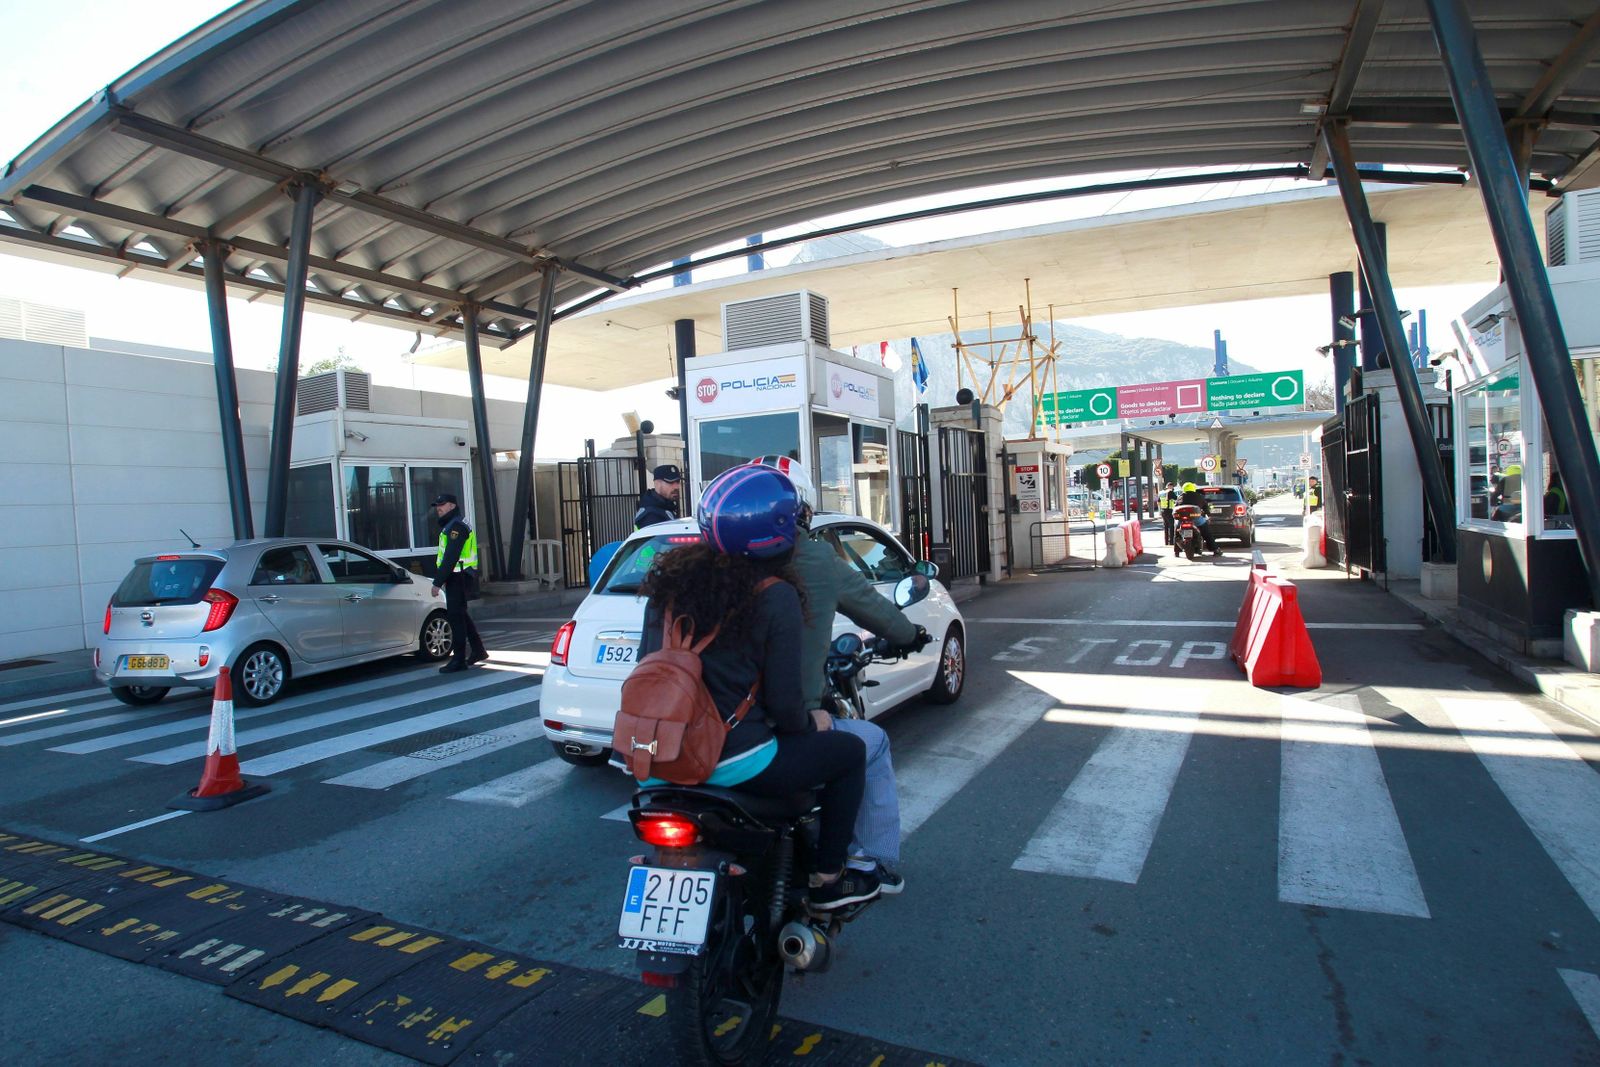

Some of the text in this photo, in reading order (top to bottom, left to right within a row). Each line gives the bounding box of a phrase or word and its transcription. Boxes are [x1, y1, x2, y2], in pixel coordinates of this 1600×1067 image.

[697, 384, 717, 397] STOP
[721, 376, 780, 391] POLICIA
[757, 383, 796, 391] NACIONAL
[1203, 459, 1213, 467] 10
[1099, 467, 1109, 475] 10
[606, 646, 640, 663] 592
[991, 636, 1227, 668] STOP
[645, 874, 711, 905] 2105
[630, 895, 639, 905] E
[640, 905, 690, 936] FFF
[618, 937, 657, 952] JJR
